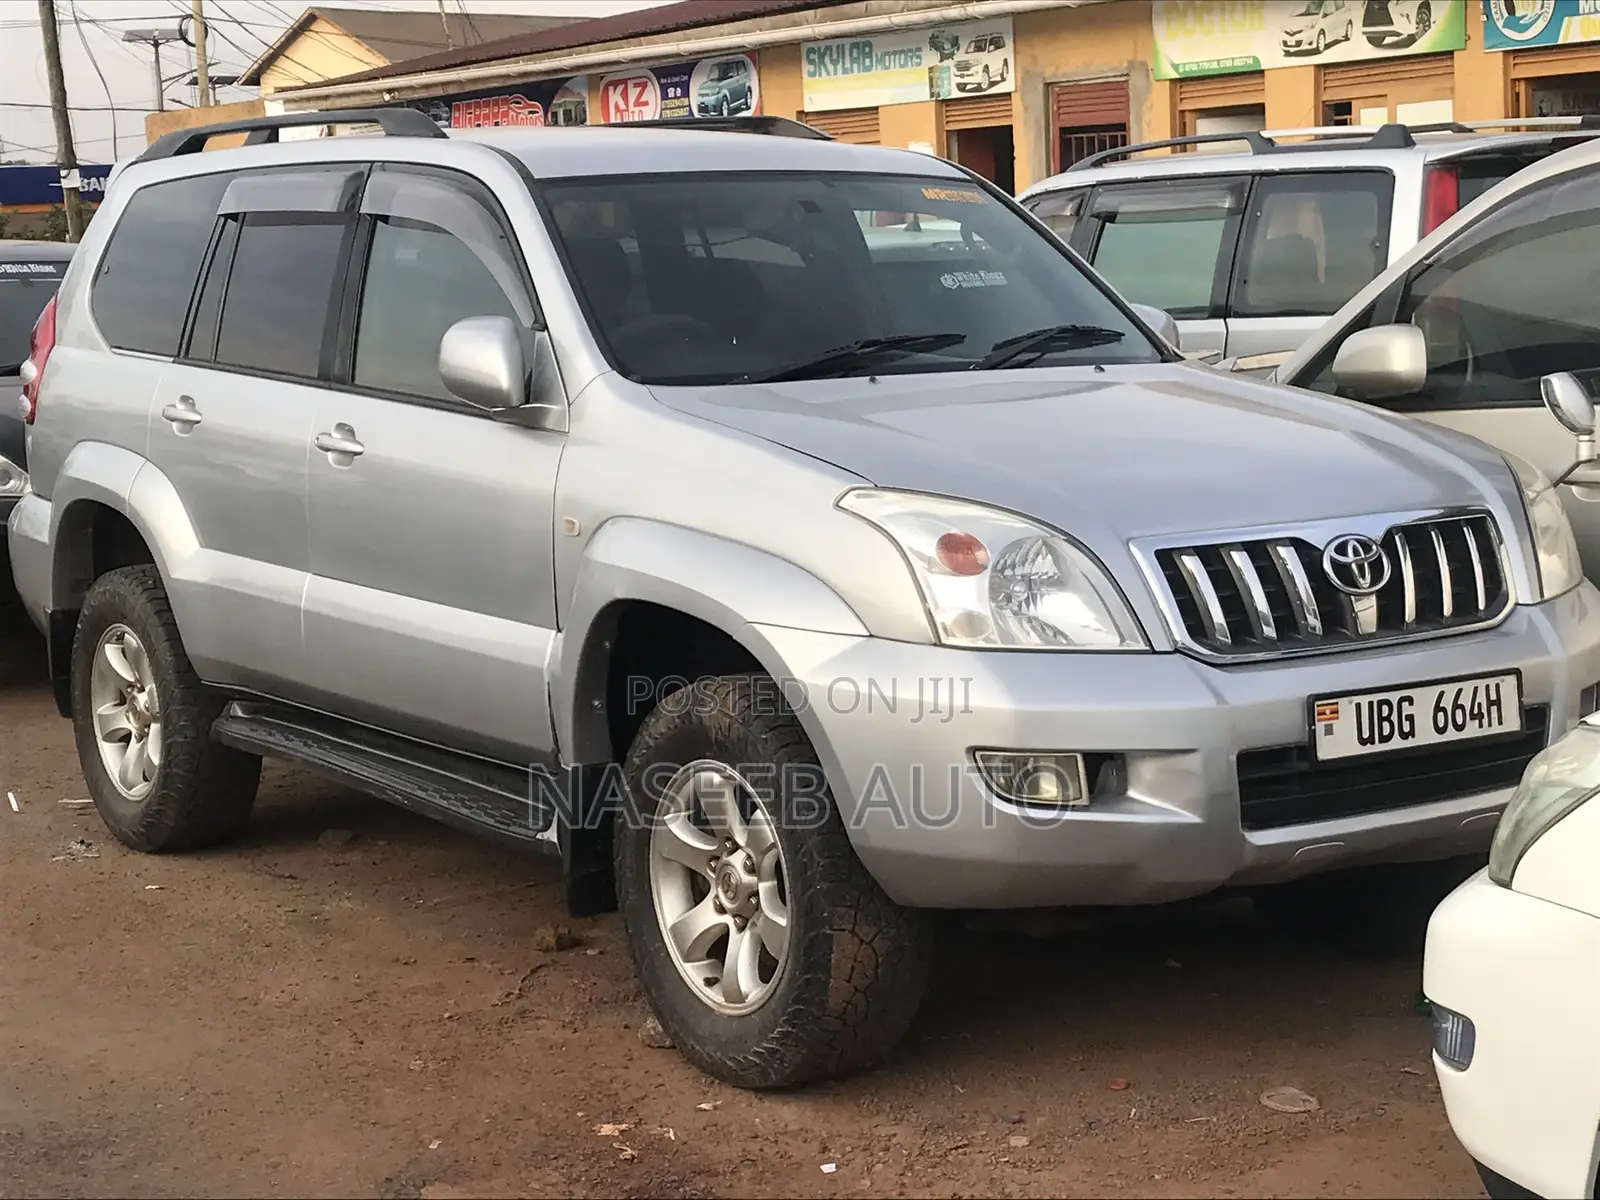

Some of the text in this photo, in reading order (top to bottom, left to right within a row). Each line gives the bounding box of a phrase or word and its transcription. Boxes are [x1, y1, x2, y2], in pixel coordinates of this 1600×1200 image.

[805, 40, 923, 78] SKYLAB MOTORS
[1355, 682, 1503, 746] UBG 664H
